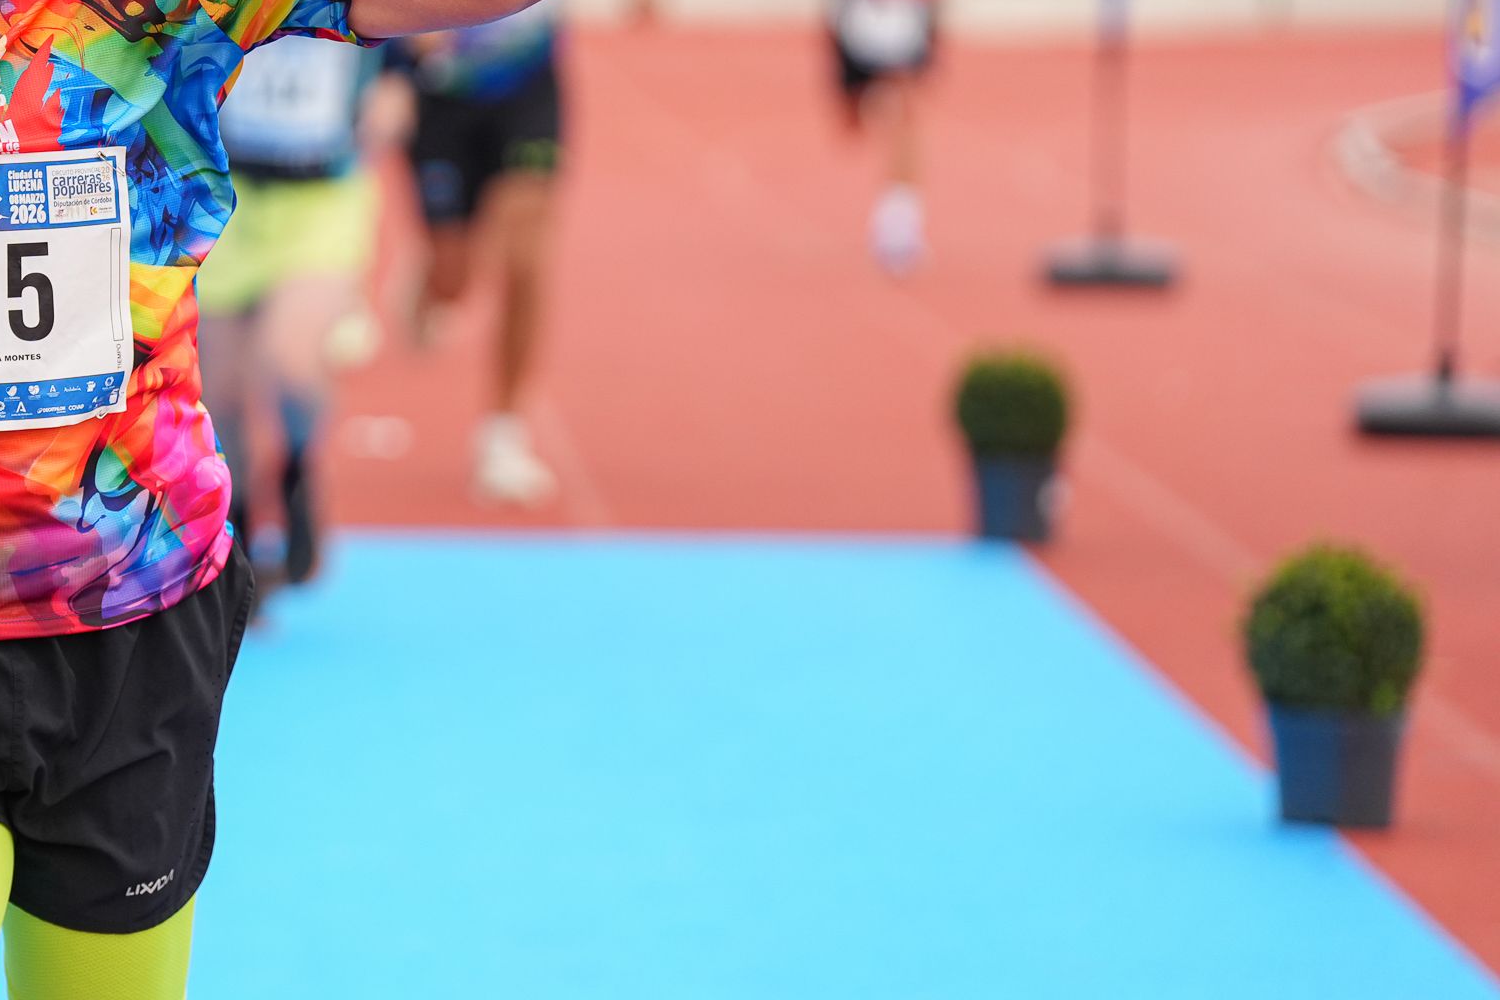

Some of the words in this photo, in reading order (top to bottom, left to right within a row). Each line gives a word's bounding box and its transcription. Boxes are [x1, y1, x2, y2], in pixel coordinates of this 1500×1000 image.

[5, 140, 20, 151] de
[8, 169, 33, 180] Ciudad
[34, 169, 43, 179] de
[52, 173, 102, 187] carreras
[8, 178, 44, 193] LUCENA
[52, 181, 112, 200] populares
[10, 204, 47, 225] 2026
[4, 353, 42, 362] MONTES
